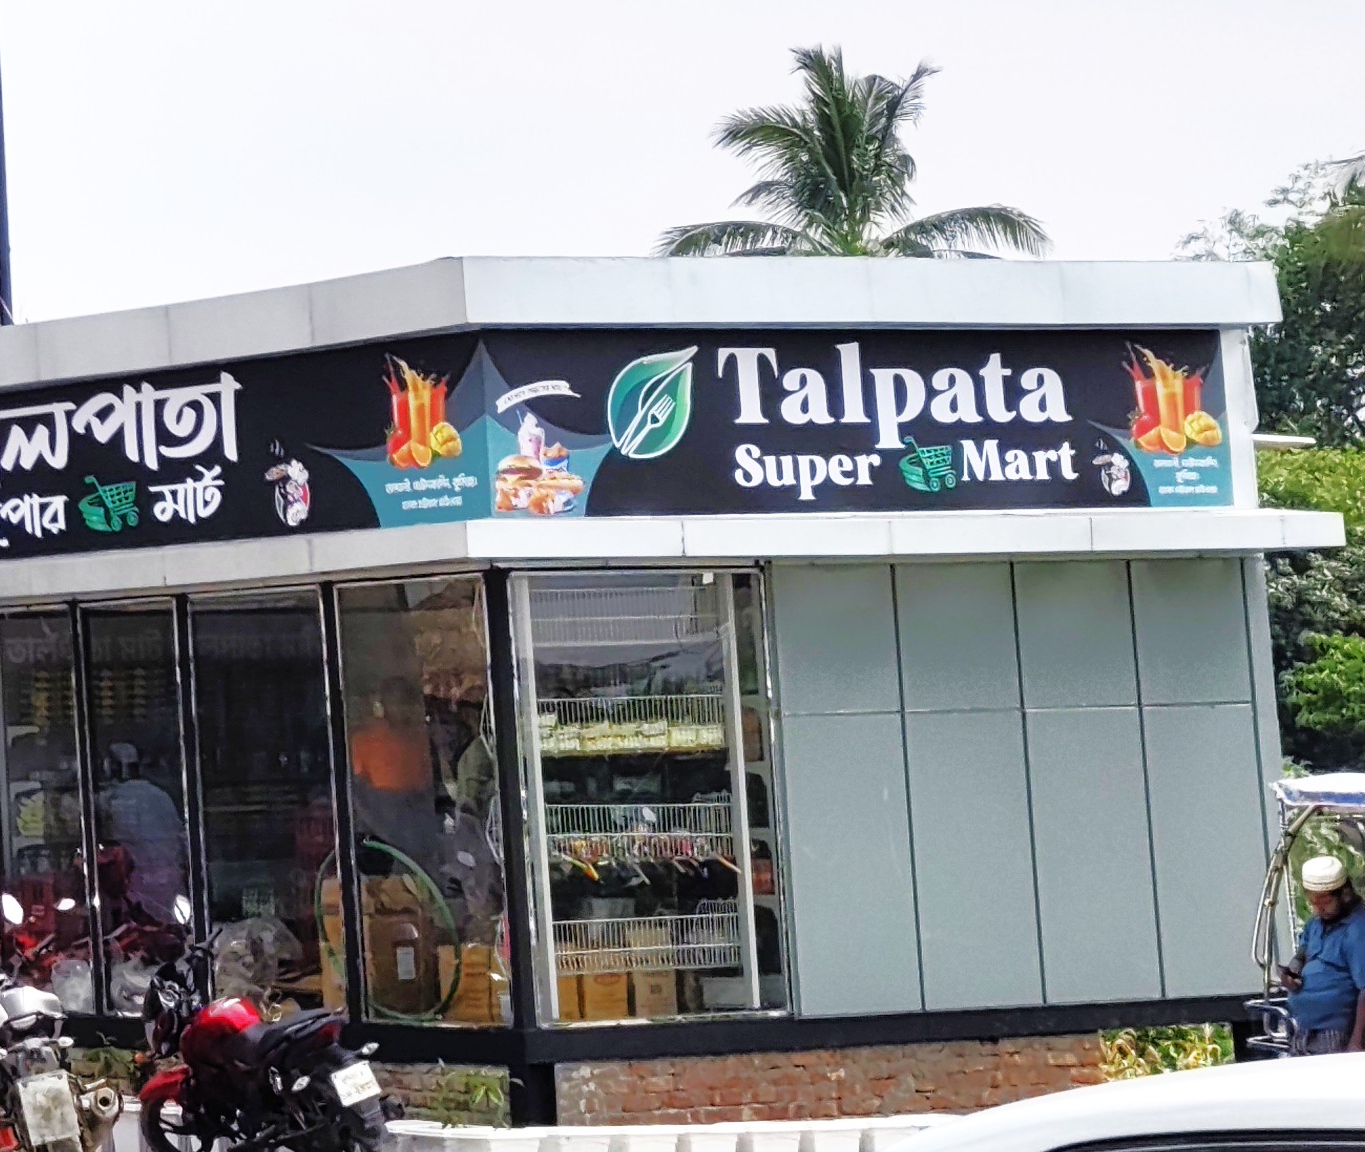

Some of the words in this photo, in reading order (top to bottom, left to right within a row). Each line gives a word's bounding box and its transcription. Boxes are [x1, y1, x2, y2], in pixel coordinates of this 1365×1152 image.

[716, 341, 1073, 449] Talpata
[148, 464, 225, 525] মার্ট
[734, 444, 881, 501] Super
[961, 439, 1080, 483] Mart
